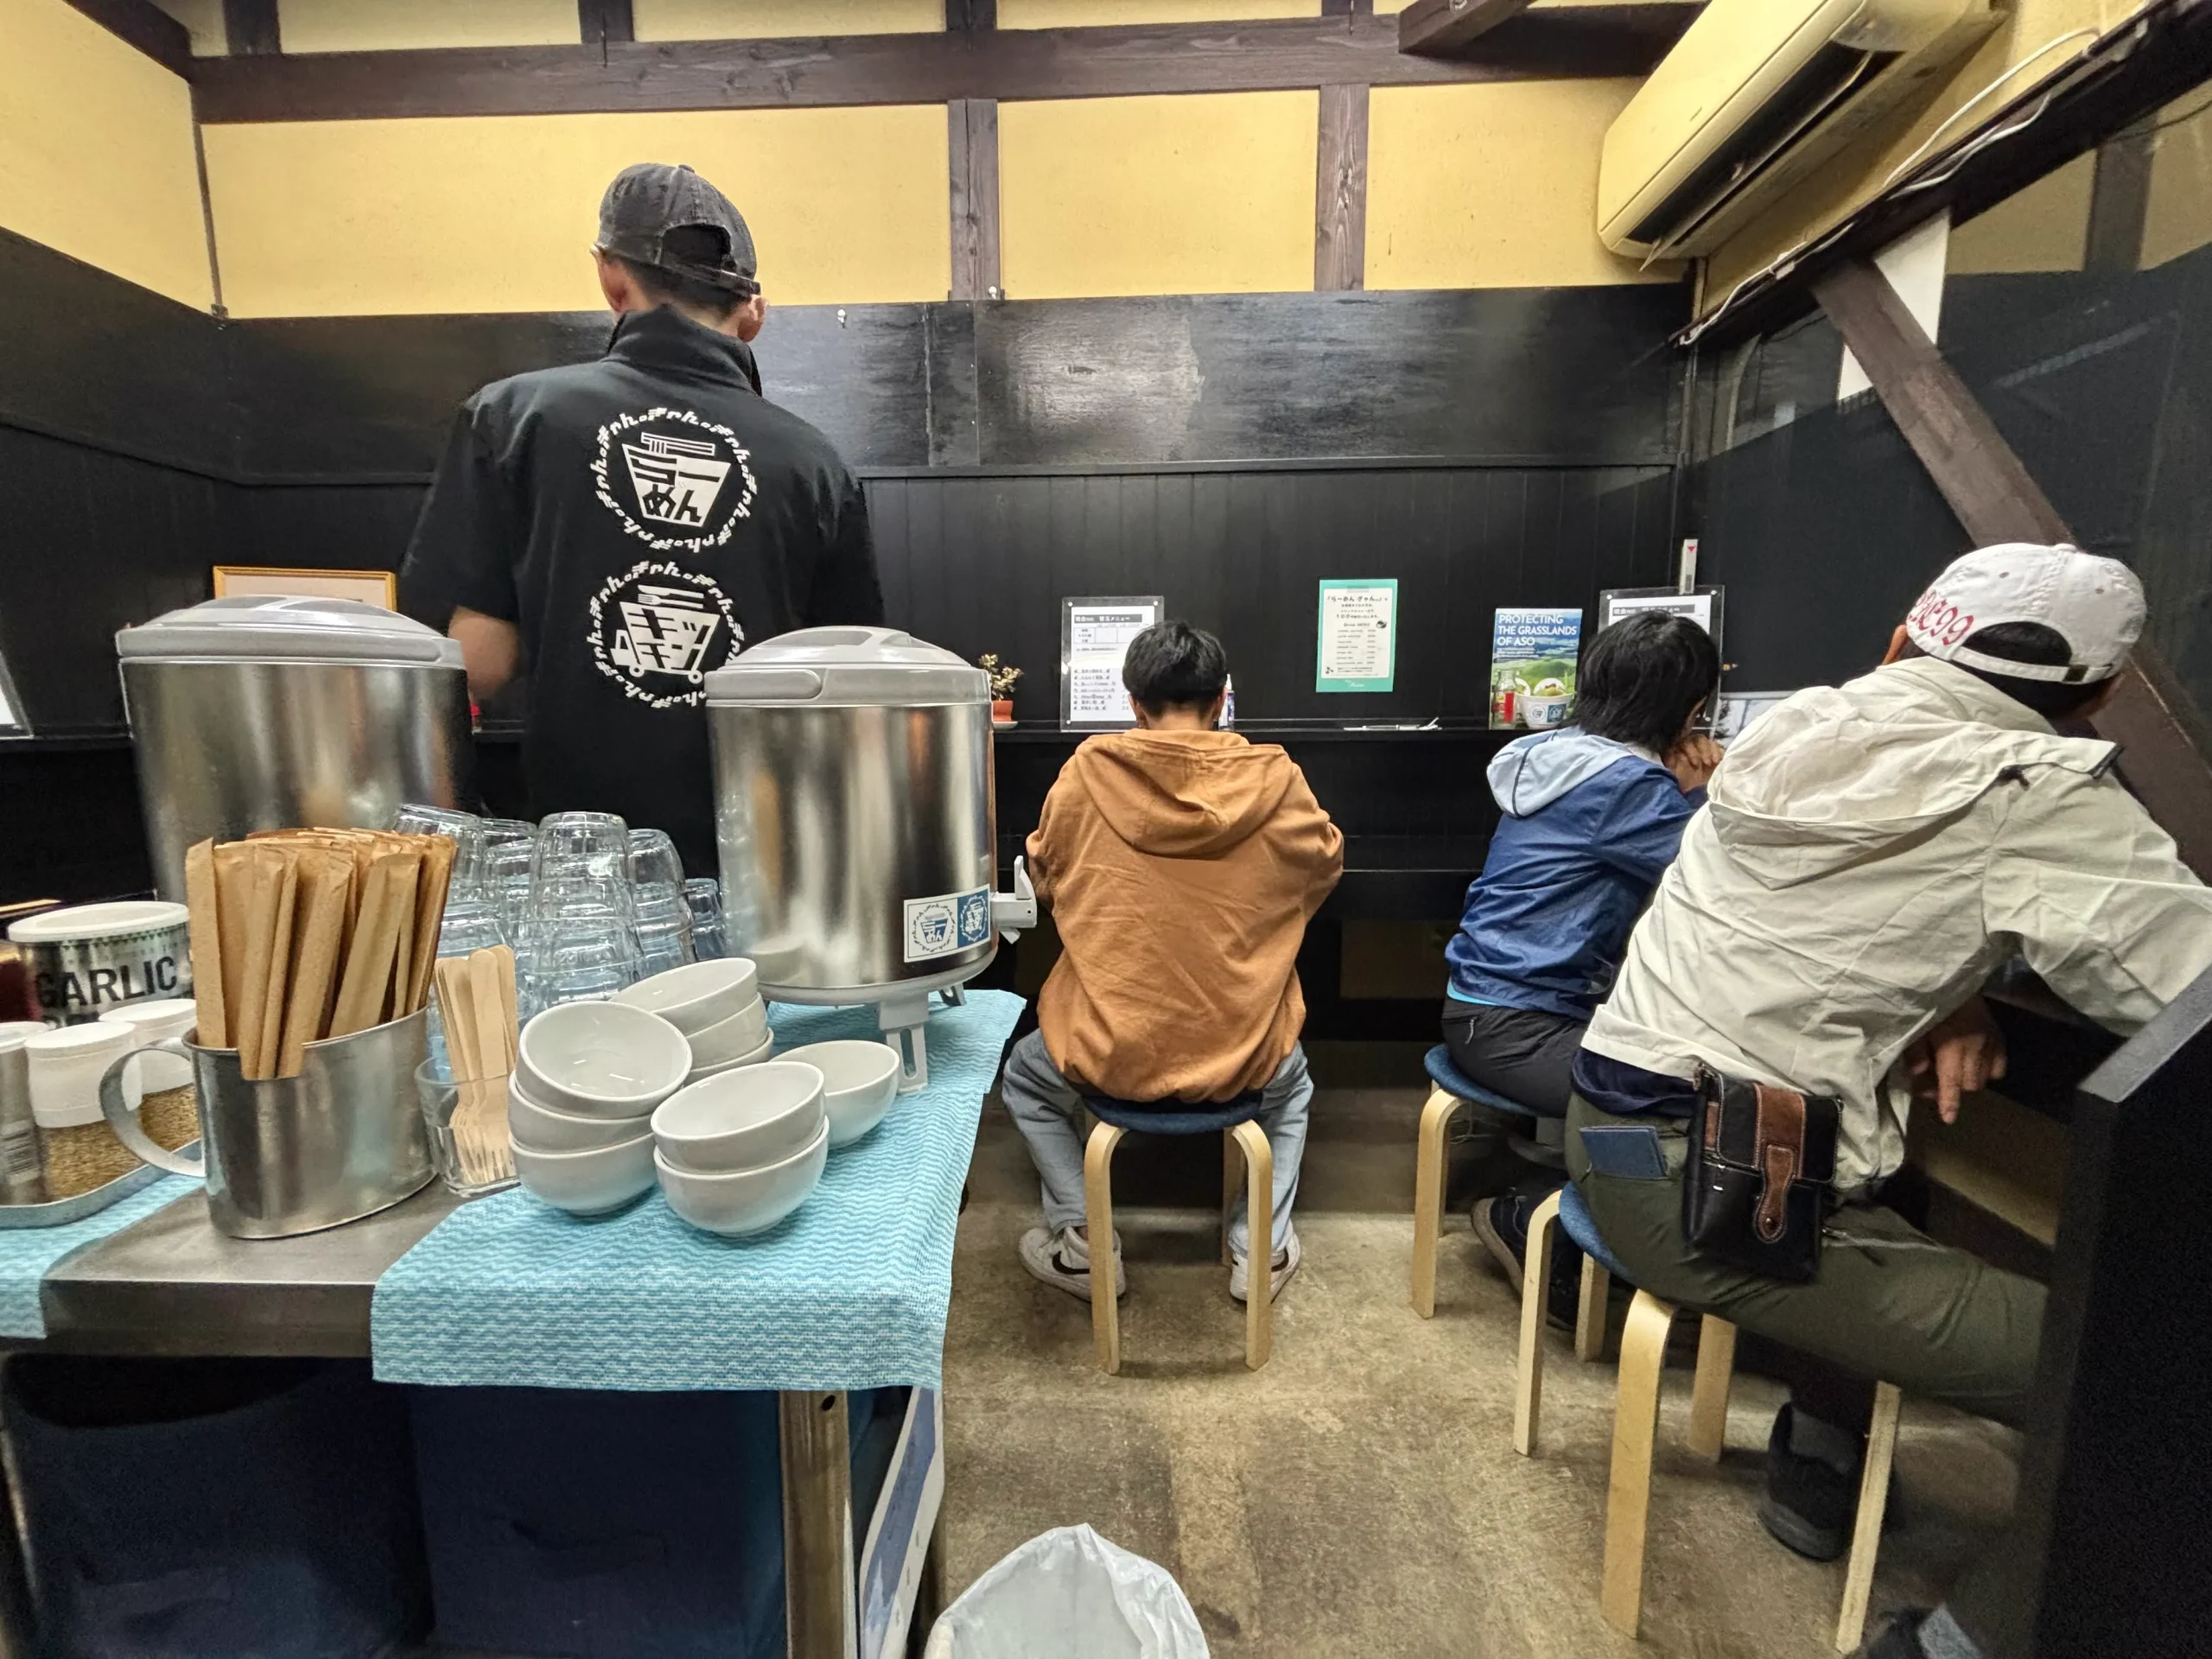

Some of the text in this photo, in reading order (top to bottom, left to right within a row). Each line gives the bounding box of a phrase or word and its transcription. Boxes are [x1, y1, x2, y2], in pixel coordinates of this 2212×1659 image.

[1498, 614, 1564, 624] PROTECTING
[1498, 626, 1577, 635] THE GRASSLANDS
[1497, 637, 1535, 645] OF ASO
[36, 956, 177, 1007] GARLIC
